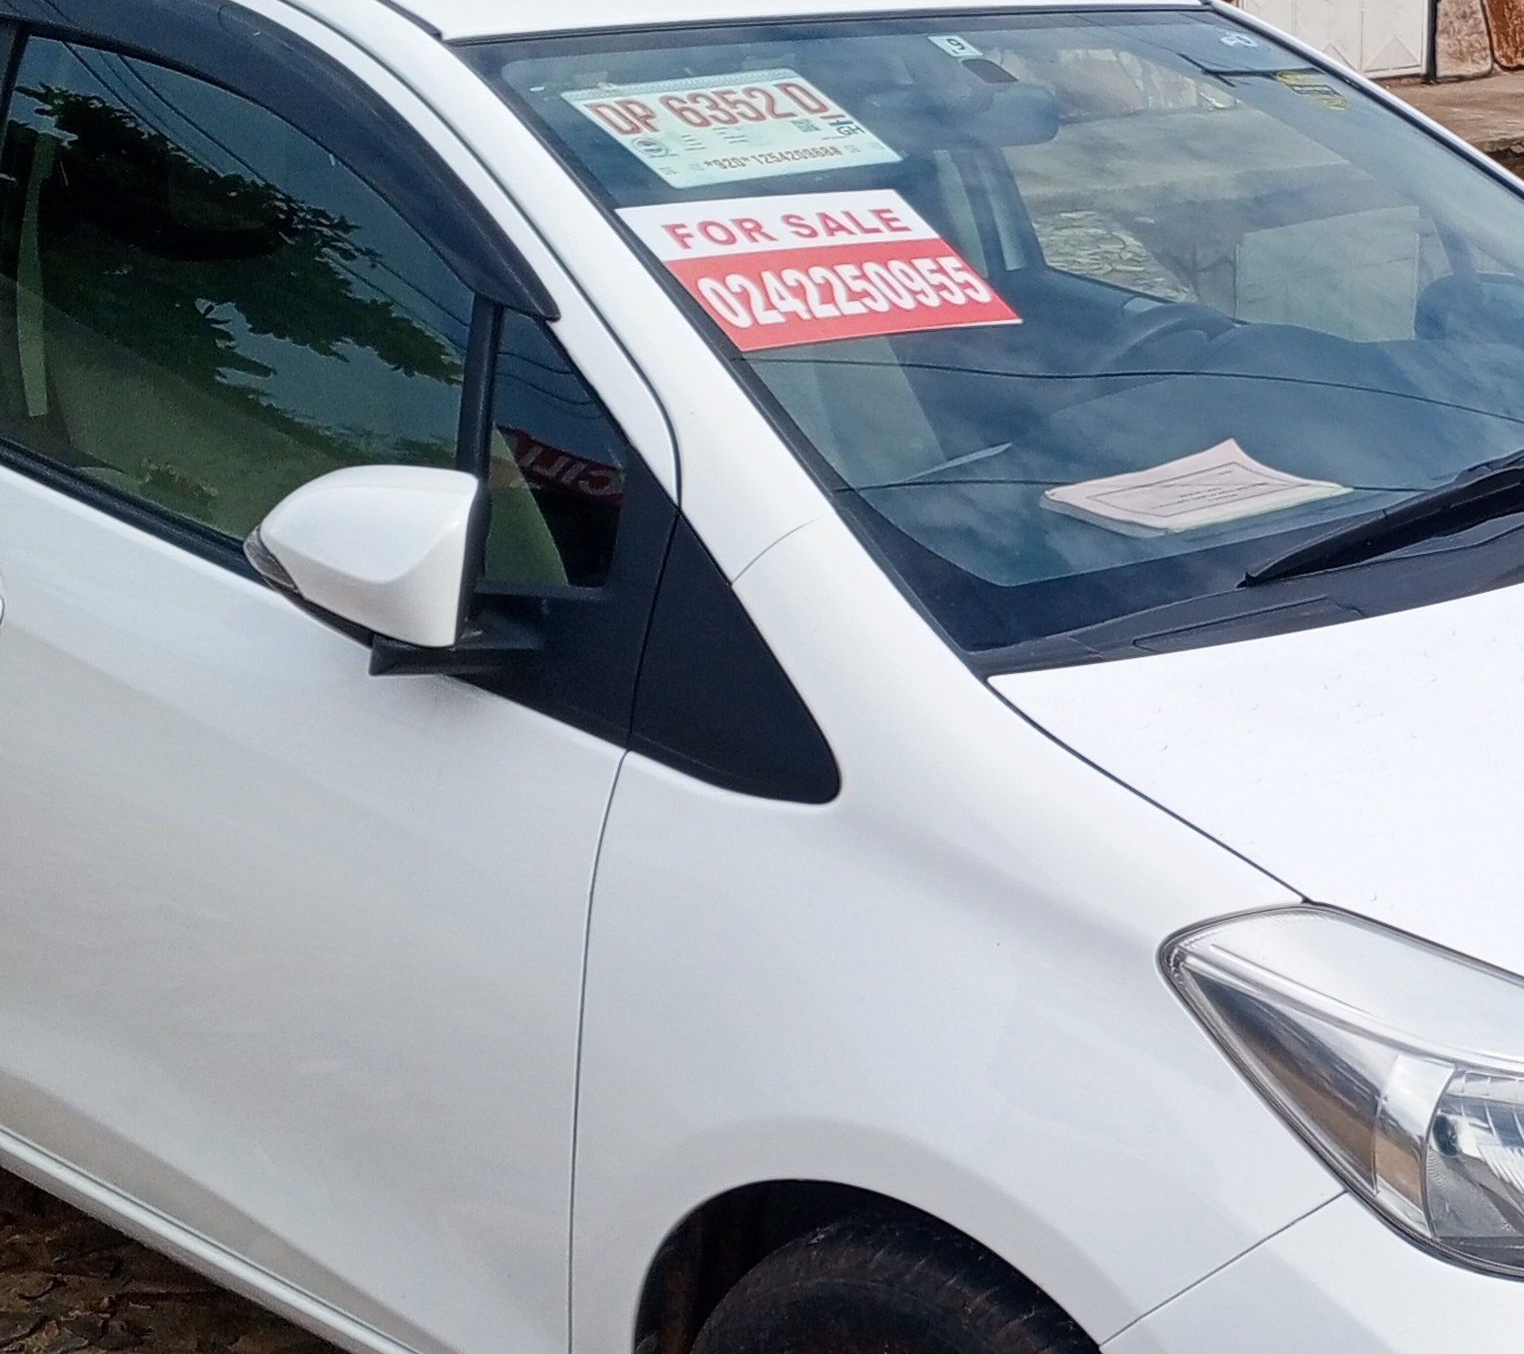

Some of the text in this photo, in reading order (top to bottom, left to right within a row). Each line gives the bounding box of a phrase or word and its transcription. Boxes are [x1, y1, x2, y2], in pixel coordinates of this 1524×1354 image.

[585, 82, 829, 136] DP 6352 D
[836, 125, 866, 137] GH
[662, 208, 912, 250] FOR SALE
[696, 257, 993, 329] 0242250955
